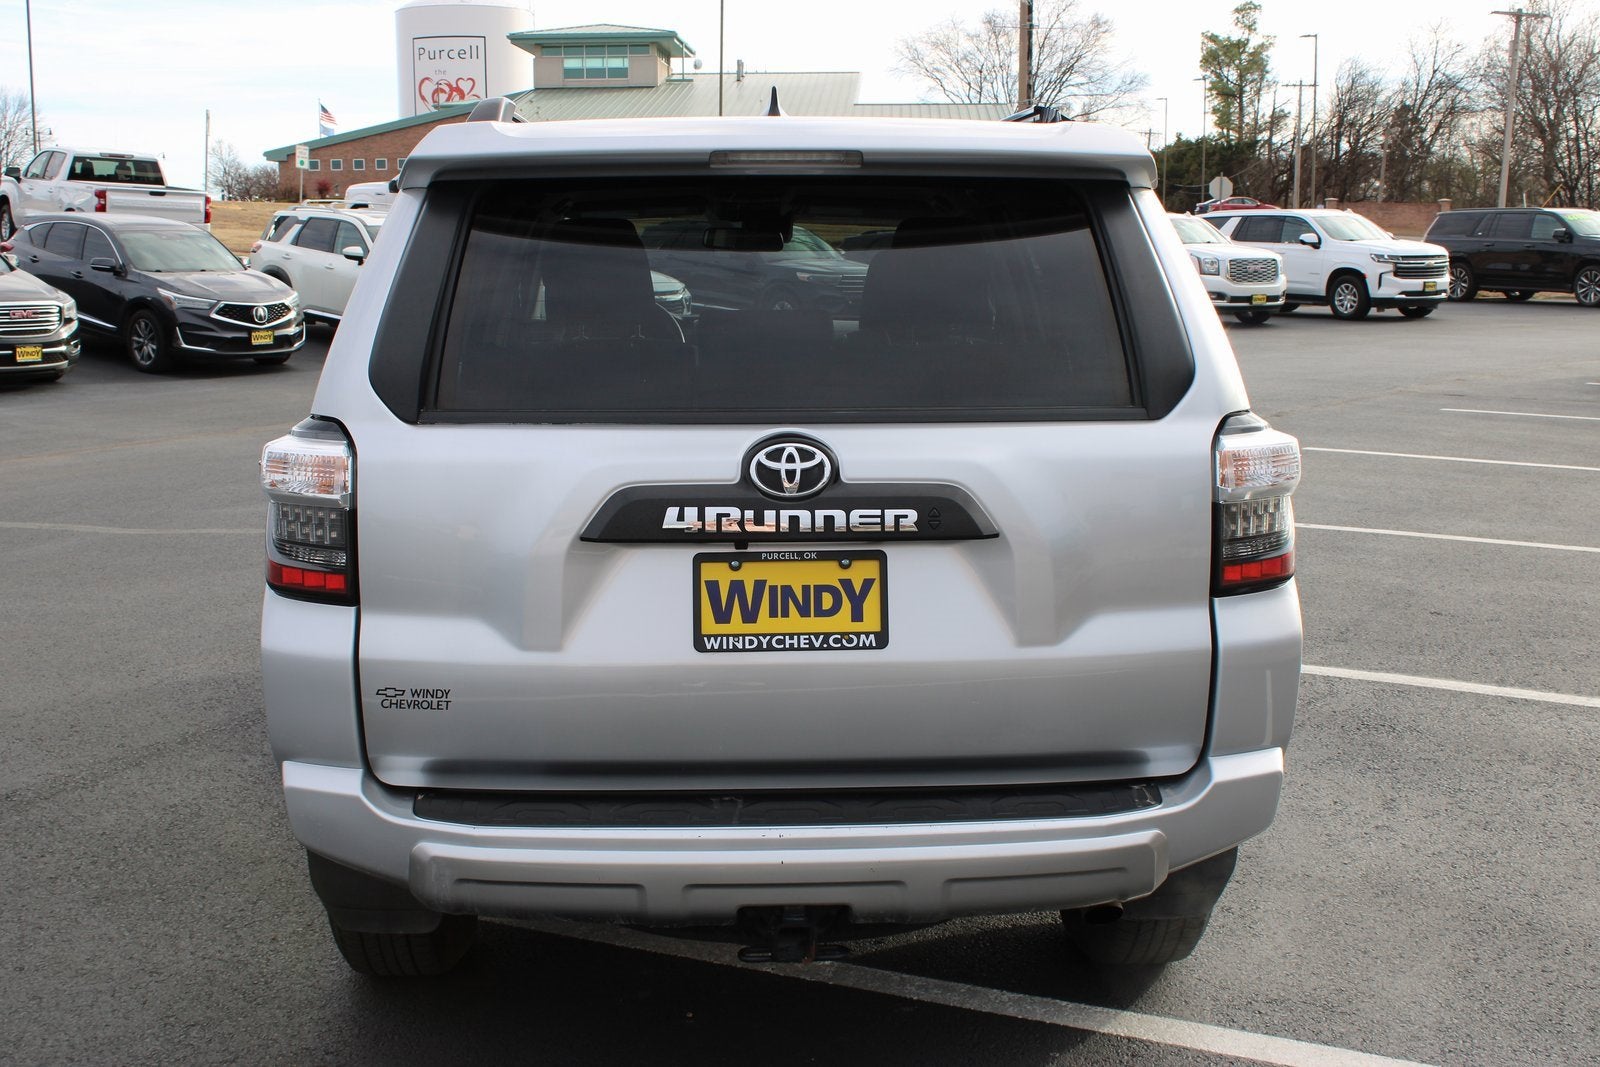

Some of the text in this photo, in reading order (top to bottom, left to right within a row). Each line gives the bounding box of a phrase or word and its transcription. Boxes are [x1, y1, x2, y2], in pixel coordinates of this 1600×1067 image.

[418, 45, 479, 61] Purcell
[10, 309, 39, 319] GMC
[761, 552, 801, 560] PURCELL,
[704, 578, 876, 624] WINDY
[703, 633, 876, 650] WINDYCHEV.COM
[410, 688, 451, 699] WINDY
[380, 698, 452, 710] CHEVROLET
